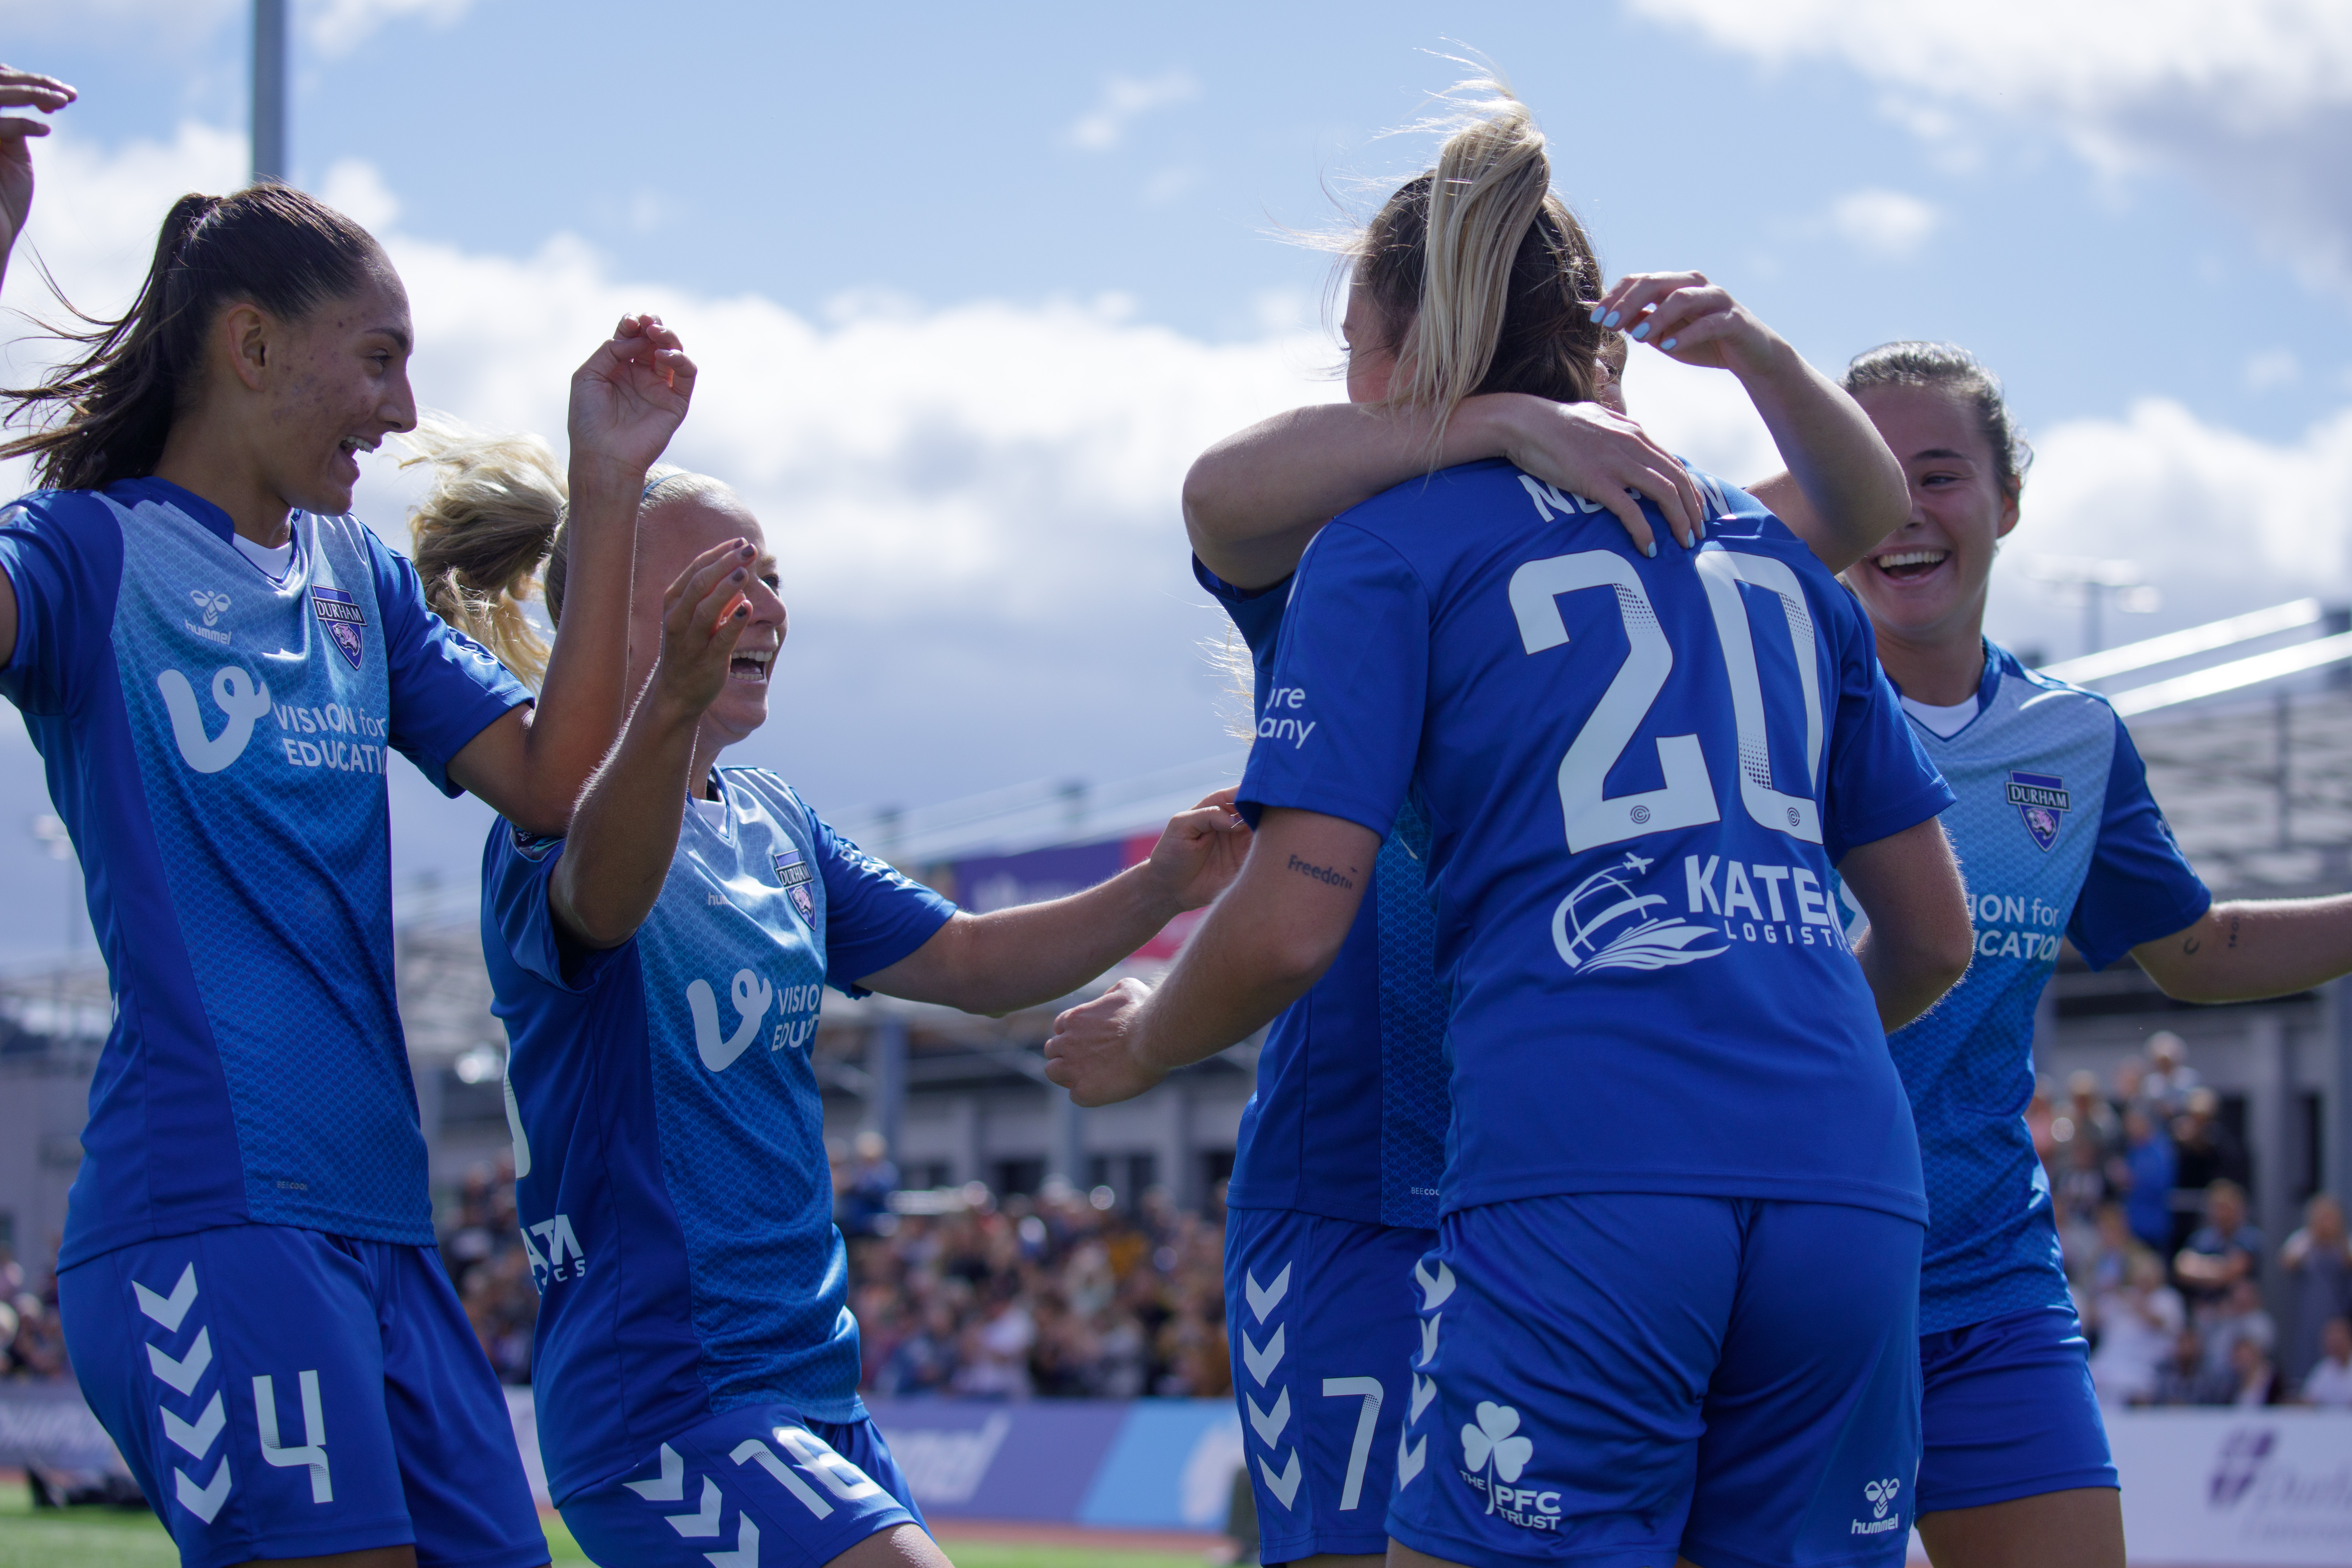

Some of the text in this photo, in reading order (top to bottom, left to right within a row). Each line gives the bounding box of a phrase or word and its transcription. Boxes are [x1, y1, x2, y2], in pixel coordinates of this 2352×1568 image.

[316, 601, 363, 622] DURHAM
[185, 619, 232, 645] hummel
[1508, 550, 1823, 855] 20
[273, 701, 386, 737] VISION for
[2012, 786, 2067, 808] DURHAM
[779, 865, 810, 886] DURHAM
[1288, 854, 1353, 889] Freedom
[2031, 897, 2059, 927] for
[778, 984, 819, 1015] VISIO
[252, 1369, 334, 1503] 4
[1323, 1376, 1384, 1510] 7
[729, 1426, 881, 1520] 16
[1460, 1470, 1561, 1514] THE PFC
[1496, 1506, 1561, 1530] TRUST
[1851, 1513, 1899, 1534] hummel
